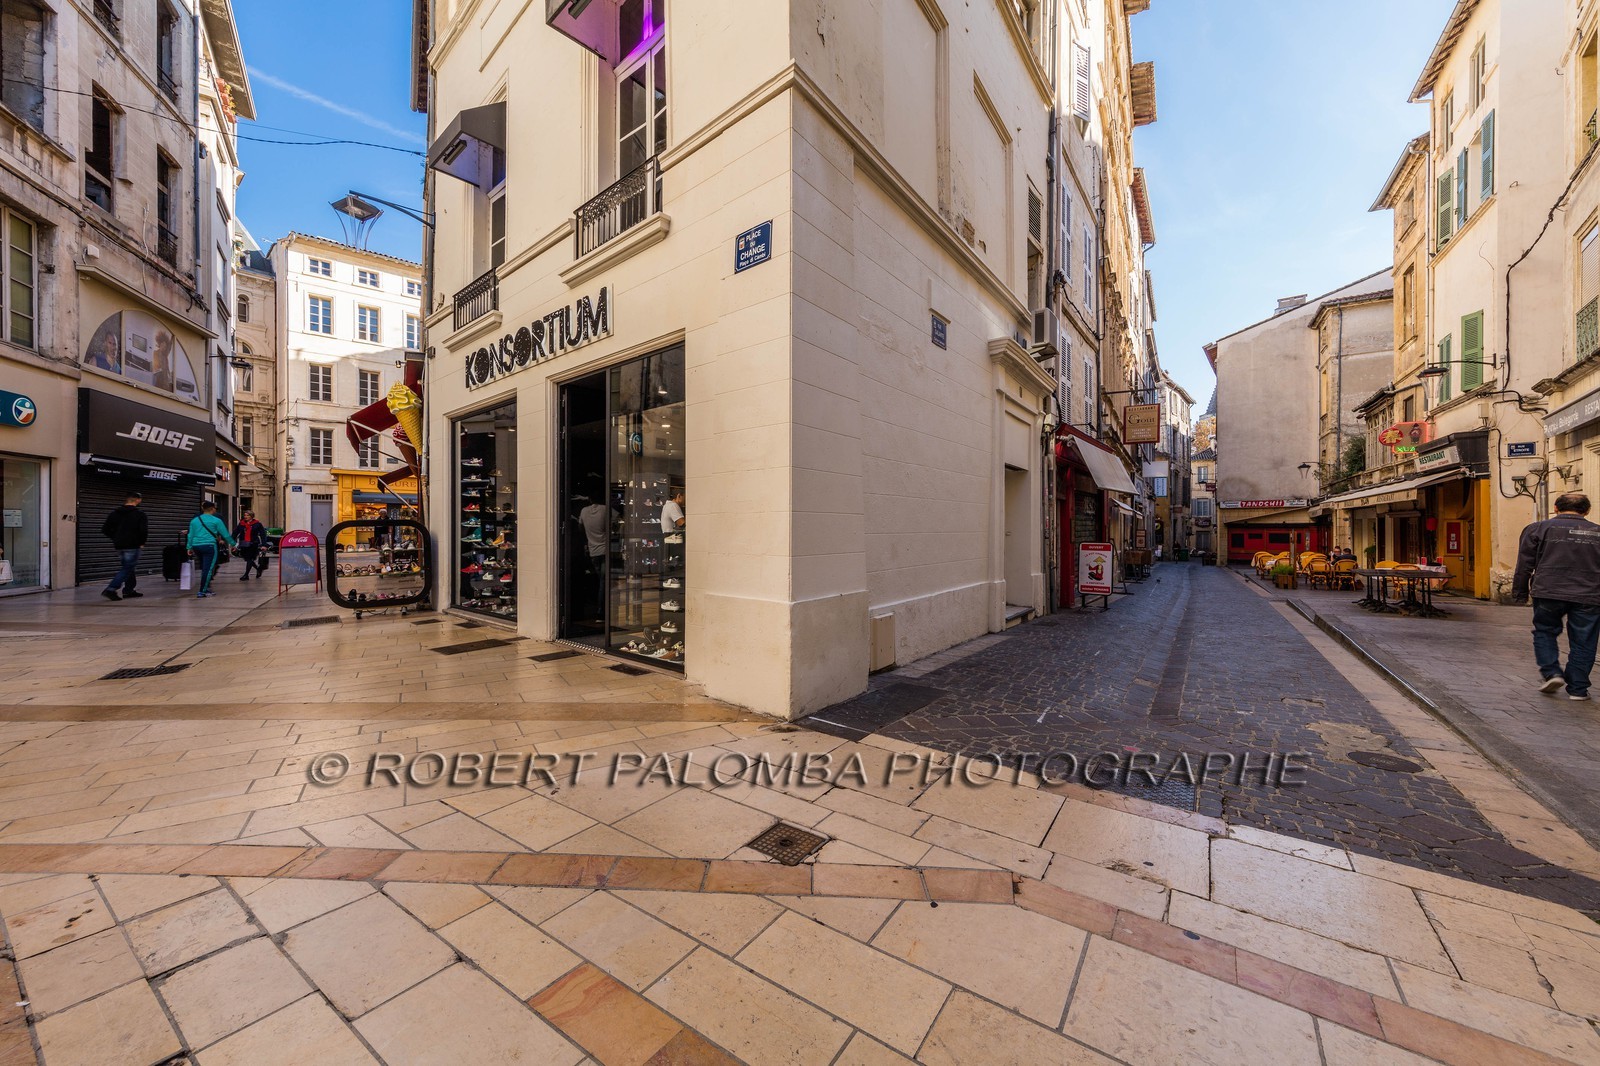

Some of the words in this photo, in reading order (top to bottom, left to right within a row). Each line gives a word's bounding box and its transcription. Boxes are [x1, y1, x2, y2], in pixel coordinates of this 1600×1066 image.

[745, 230, 761, 242] PLACE
[740, 243, 766, 260] CHANGE
[465, 285, 608, 388] KONSORTIUM
[1584, 398, 1600, 415] RESTA
[115, 421, 202, 452] BOSE
[1419, 450, 1446, 464] RESTAURANT
[143, 470, 182, 481] BOSE
